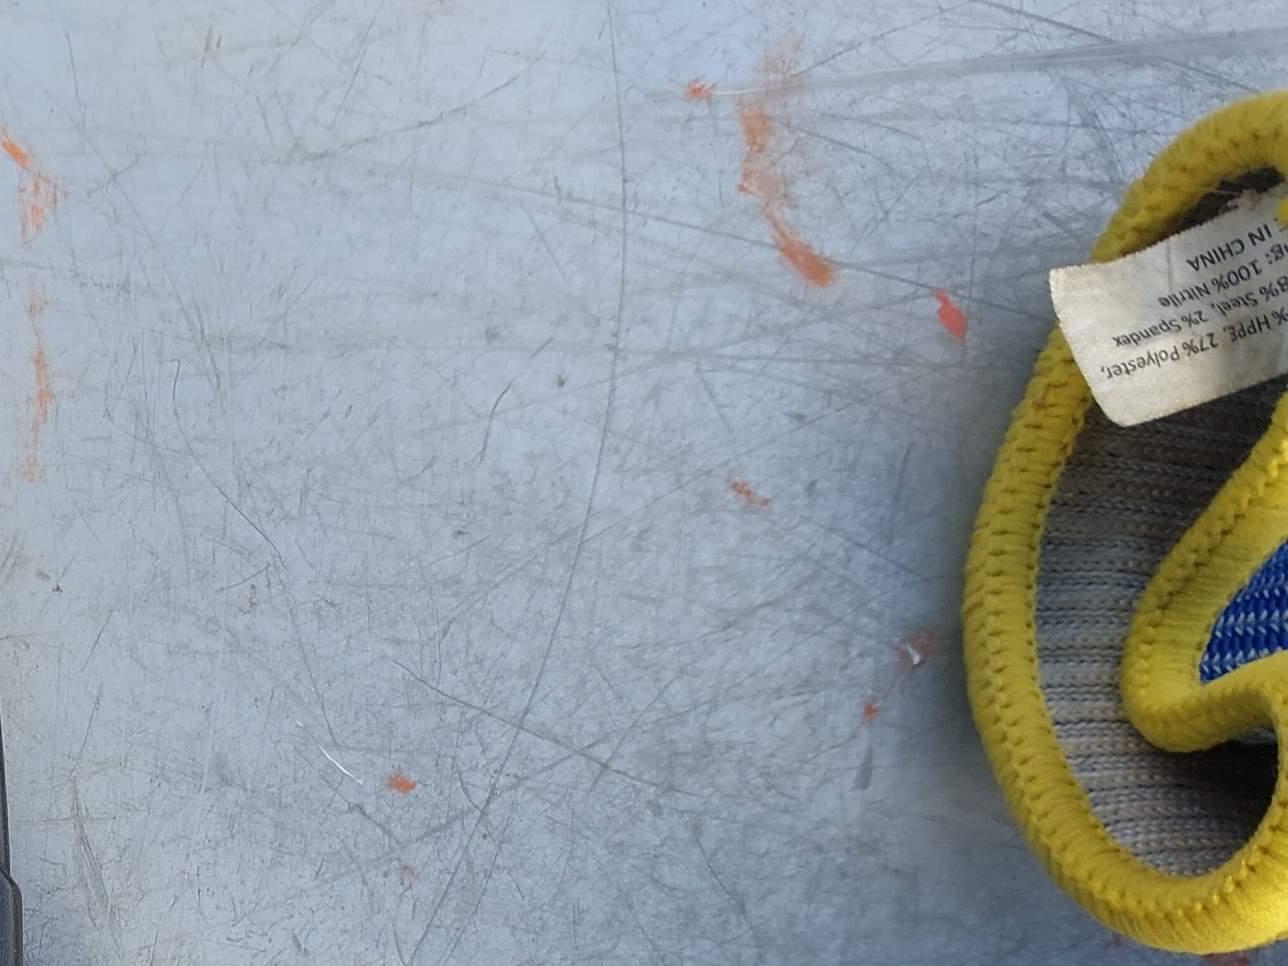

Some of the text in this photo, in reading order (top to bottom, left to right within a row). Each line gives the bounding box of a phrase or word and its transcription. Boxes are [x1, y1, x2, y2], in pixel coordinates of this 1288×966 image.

[1248, 224, 1272, 246] IN
[1186, 238, 1244, 271] CHINA
[1212, 258, 1262, 288] 100%
[1157, 282, 1210, 308] Nitrile
[1211, 292, 1258, 316] Steel,
[1181, 310, 1209, 329] 2%
[1112, 319, 1182, 347] Spandex
[1182, 332, 1219, 358] 27%
[1100, 344, 1181, 380] Polyester,
